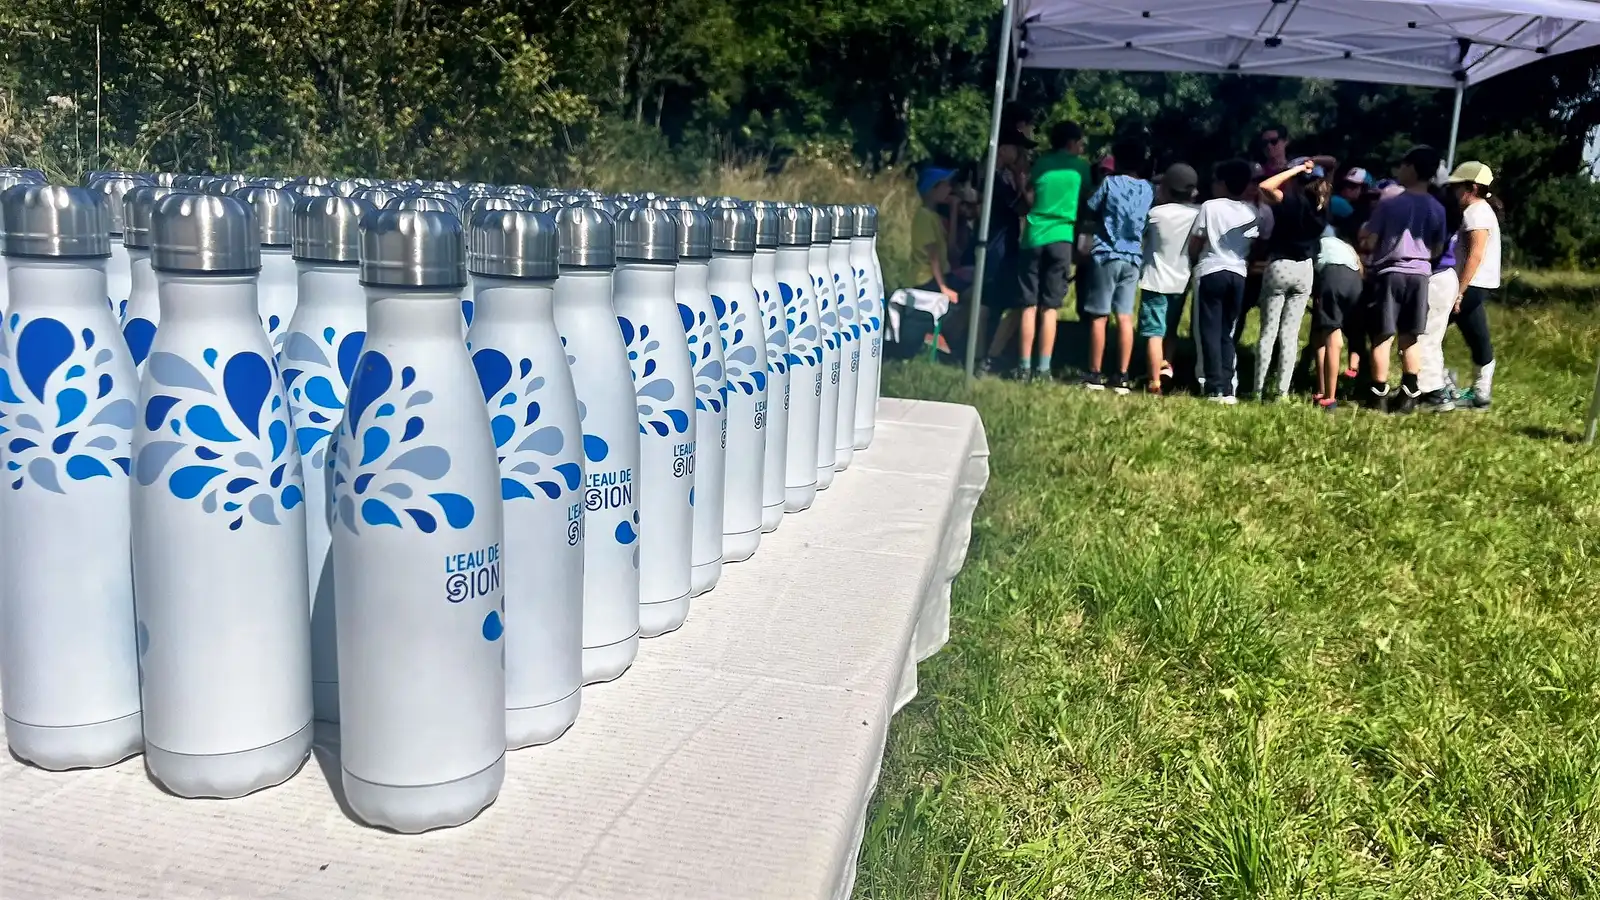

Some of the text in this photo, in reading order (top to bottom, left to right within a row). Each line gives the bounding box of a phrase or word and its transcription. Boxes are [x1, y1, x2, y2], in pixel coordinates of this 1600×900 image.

[674, 442, 693, 457] L'EAU
[585, 468, 632, 488] L'EAU DE
[673, 454, 695, 478] SIO
[585, 483, 632, 511] SION
[446, 543, 499, 573] L'EAU DE
[446, 561, 499, 603] SION
